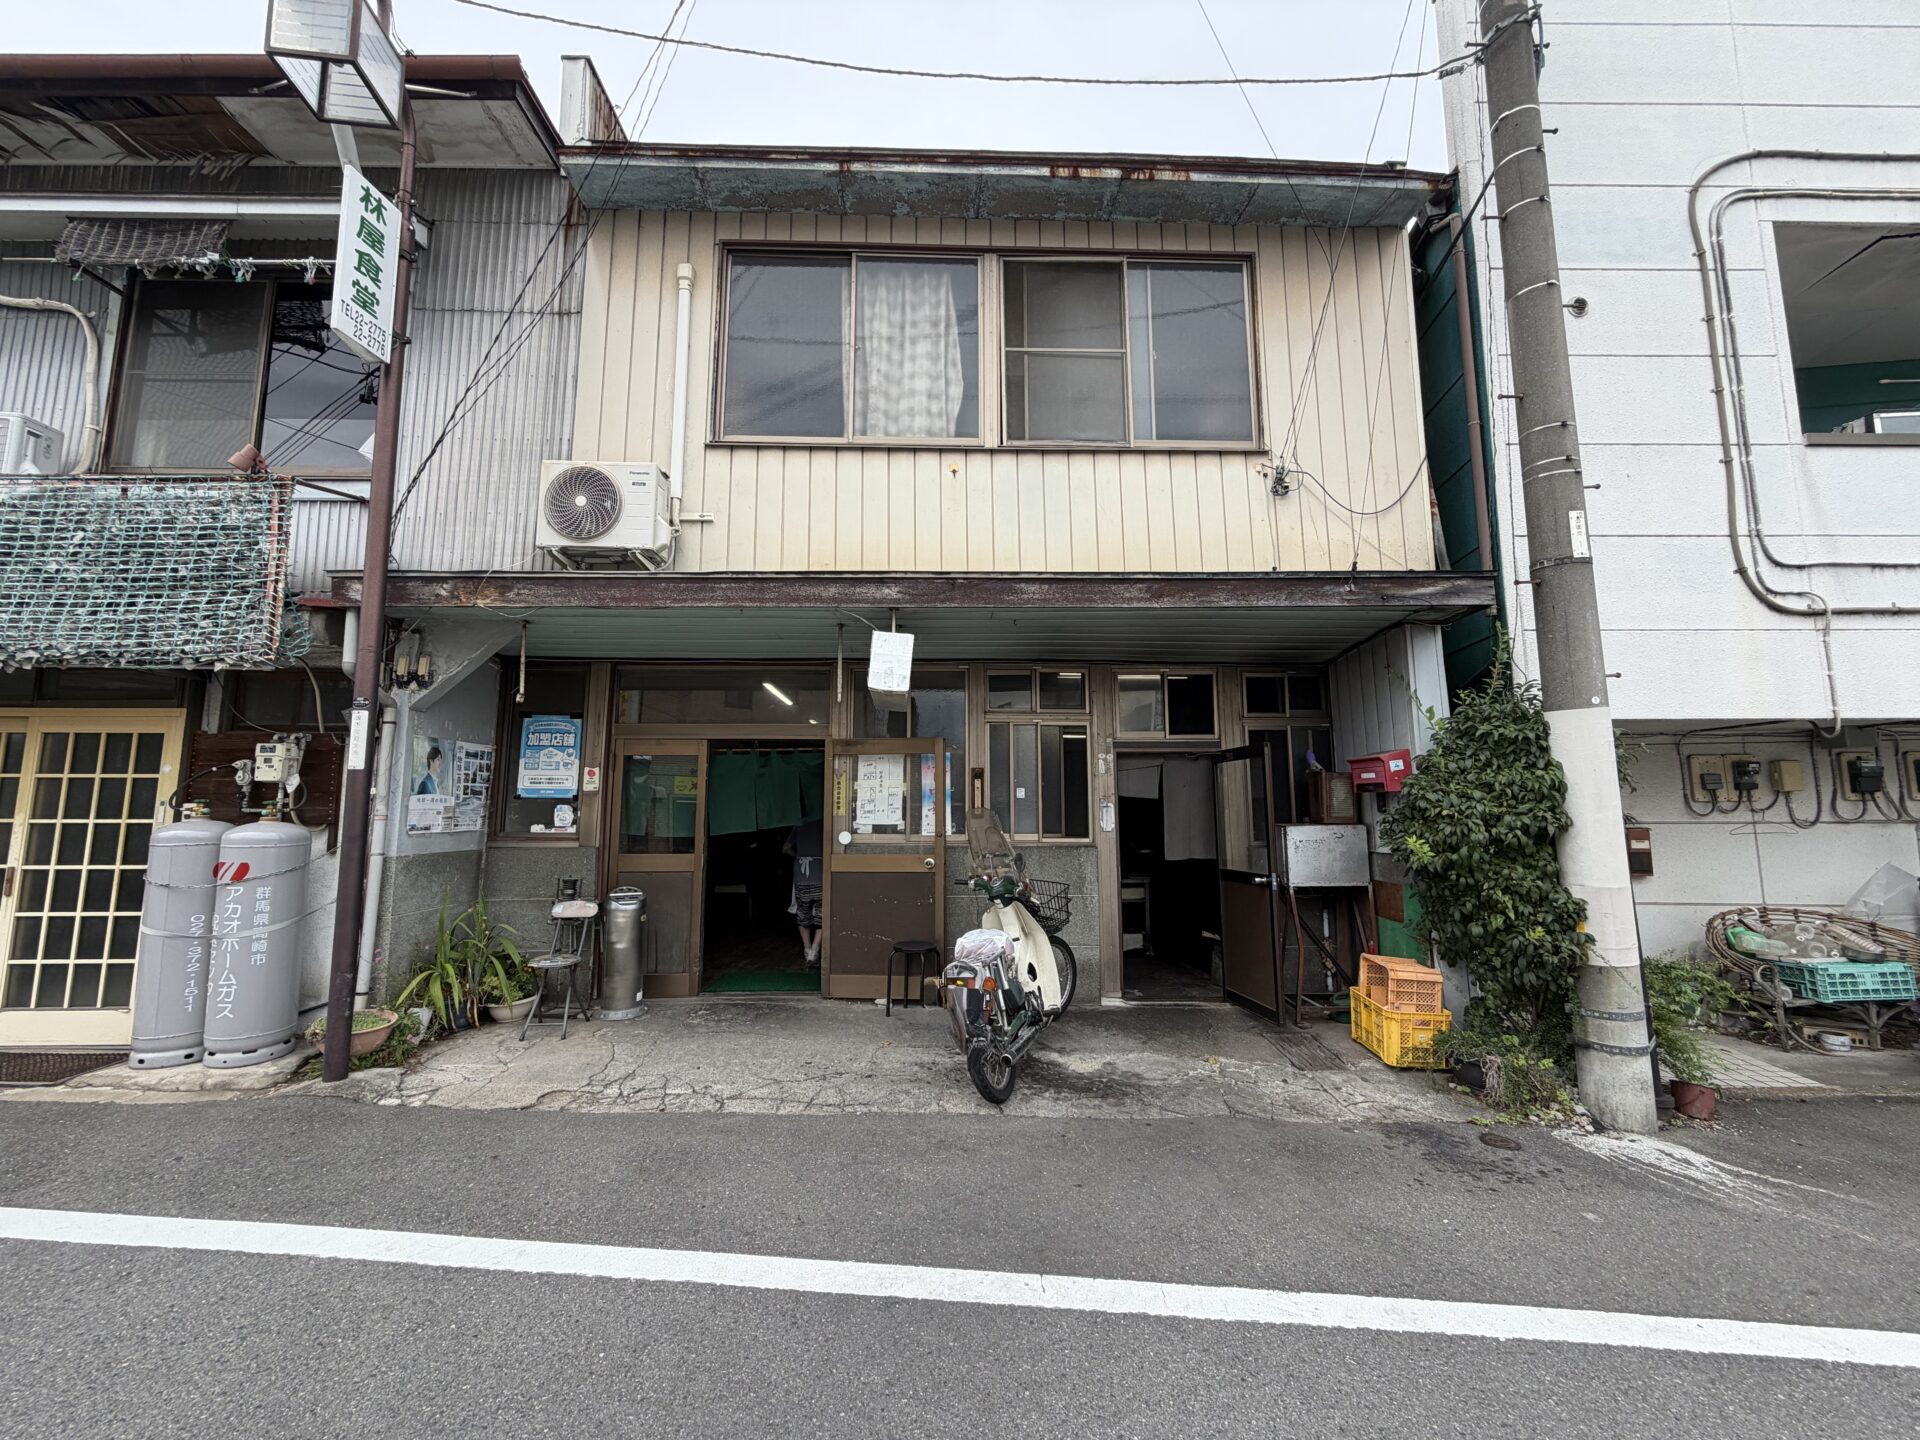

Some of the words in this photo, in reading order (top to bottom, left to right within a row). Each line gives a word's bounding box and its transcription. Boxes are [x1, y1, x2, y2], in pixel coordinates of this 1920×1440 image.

[350, 184, 388, 320] 林屋食堂
[353, 325, 386, 357] 22-2776
[527, 732, 576, 747] 加盟店舗
[215, 886, 244, 1019] アカオホームガス
